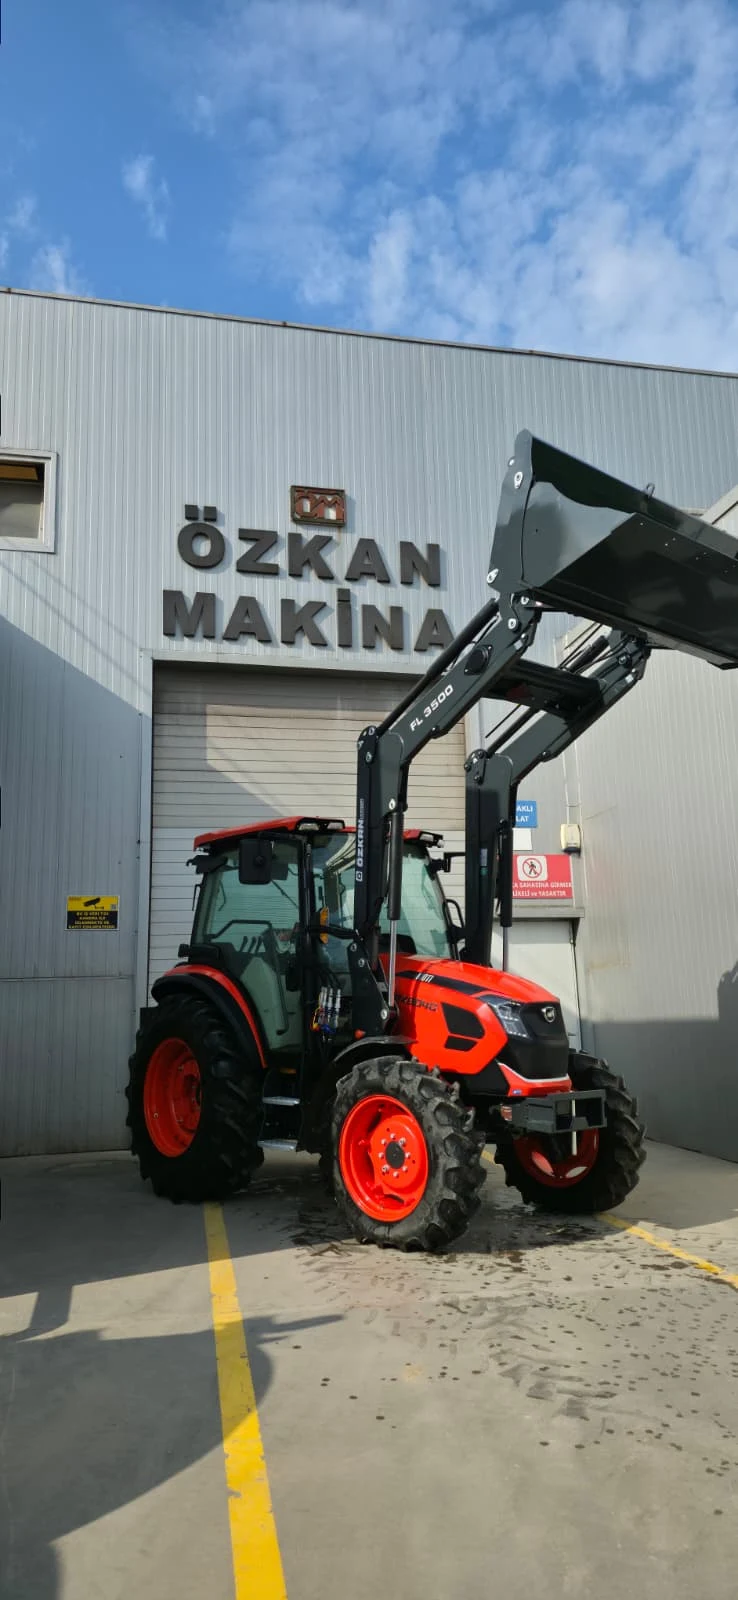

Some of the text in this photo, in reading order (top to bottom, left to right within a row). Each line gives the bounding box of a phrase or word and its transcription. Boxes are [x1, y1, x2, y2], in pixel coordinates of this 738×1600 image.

[177, 504, 440, 587] ÖZKAN
[162, 588, 455, 651] MAKİNA
[410, 684, 454, 731] FL 3500
